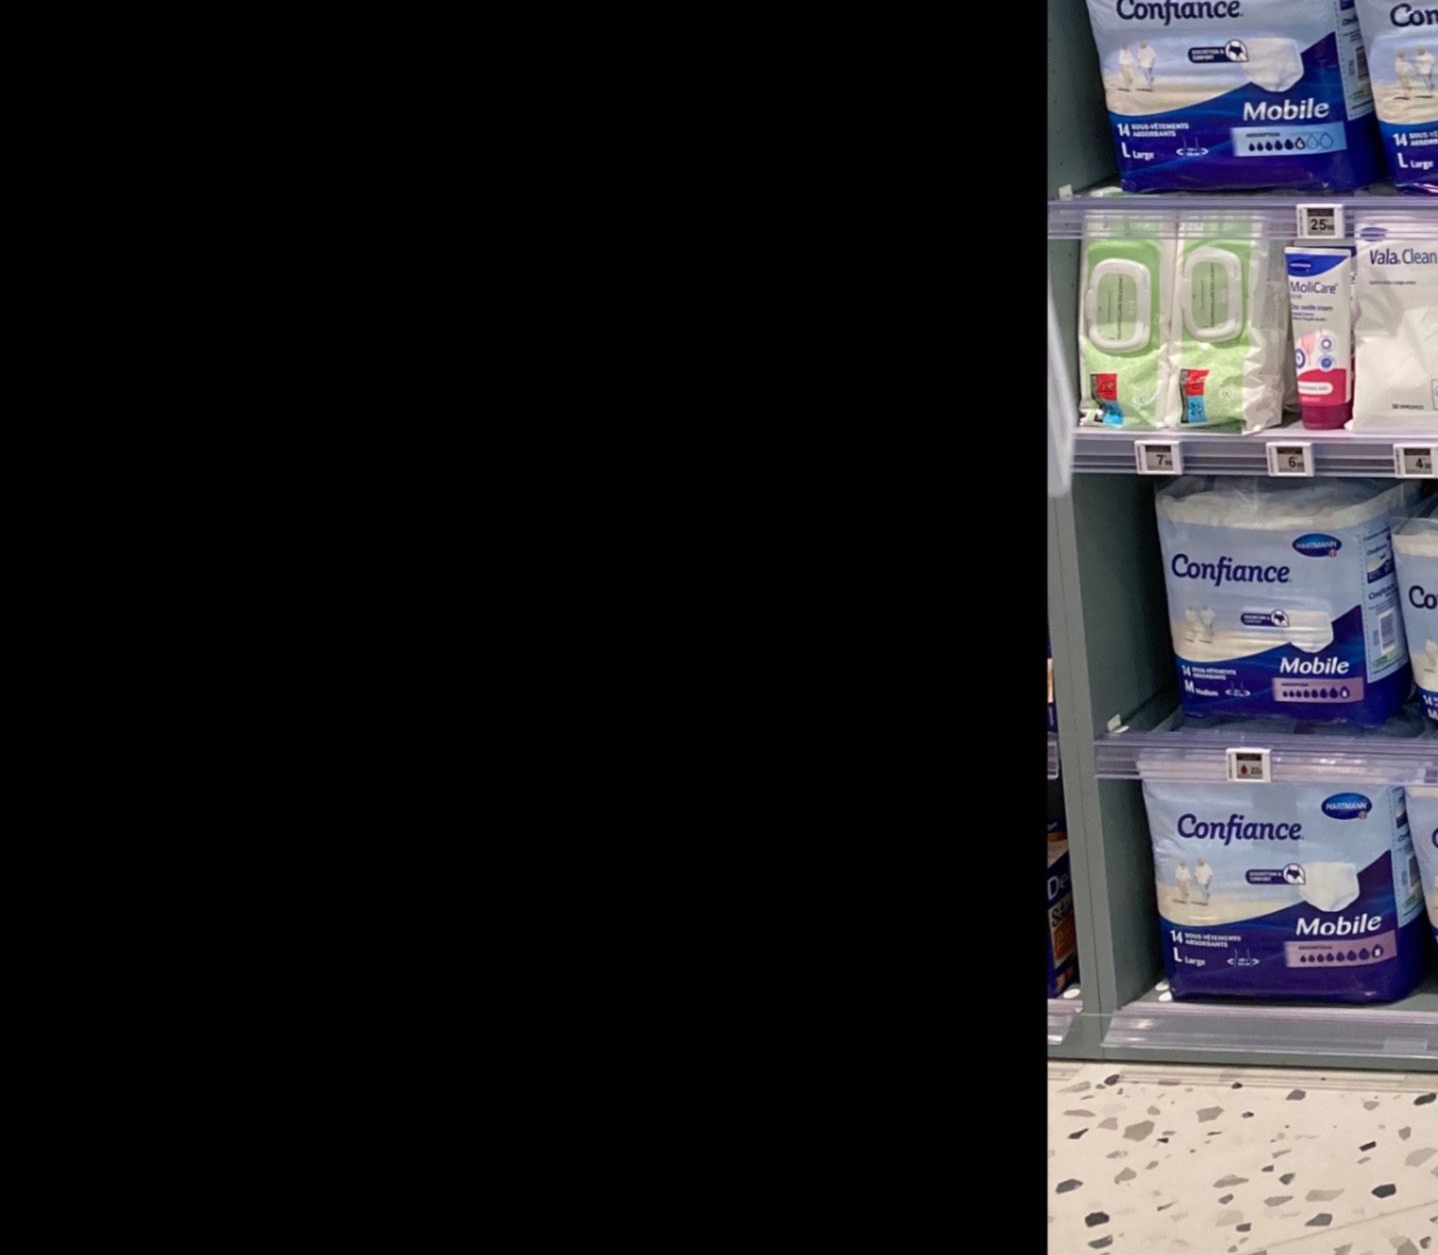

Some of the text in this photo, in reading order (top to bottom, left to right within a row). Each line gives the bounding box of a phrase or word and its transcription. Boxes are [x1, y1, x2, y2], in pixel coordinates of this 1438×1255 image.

[1243, 98, 1329, 122] Mobile
[1117, 123, 1130, 137] 14
[1392, 133, 1408, 147] 14
[1121, 142, 1155, 161] L Large
[1397, 152, 1408, 169] L
[1310, 219, 1326, 231] 25
[1369, 248, 1438, 265] Vala Clean
[1290, 282, 1337, 295] MoliCare
[1172, 554, 1290, 586] Confiance
[1279, 657, 1350, 675] Mobile
[1184, 679, 1195, 693] M
[1177, 813, 1303, 846] Confiance
[1296, 913, 1382, 936] Mobile
[1169, 930, 1183, 945] 14
[1173, 947, 1183, 962] L
